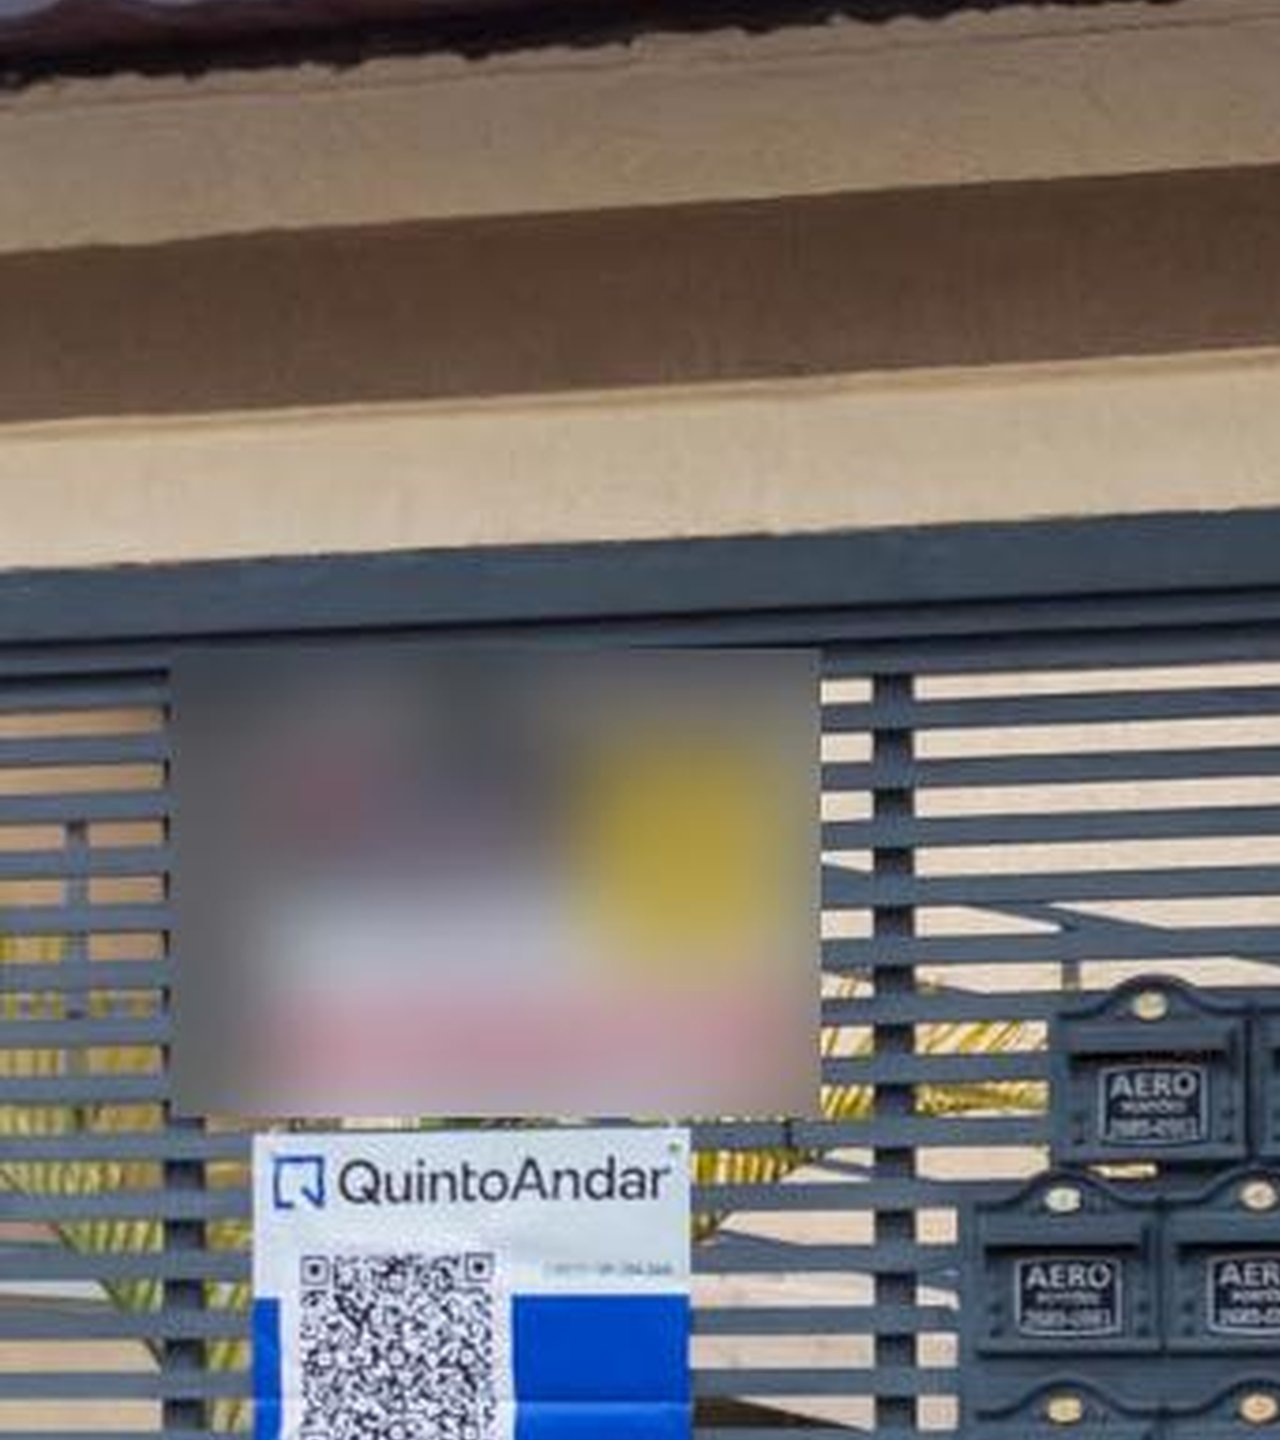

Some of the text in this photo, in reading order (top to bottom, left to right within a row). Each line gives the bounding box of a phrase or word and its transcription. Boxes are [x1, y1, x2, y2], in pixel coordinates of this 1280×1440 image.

[1110, 1071, 1197, 1098] AERO
[338, 1155, 671, 1205] QuintoAndar
[1026, 1263, 1112, 1290] AERO
